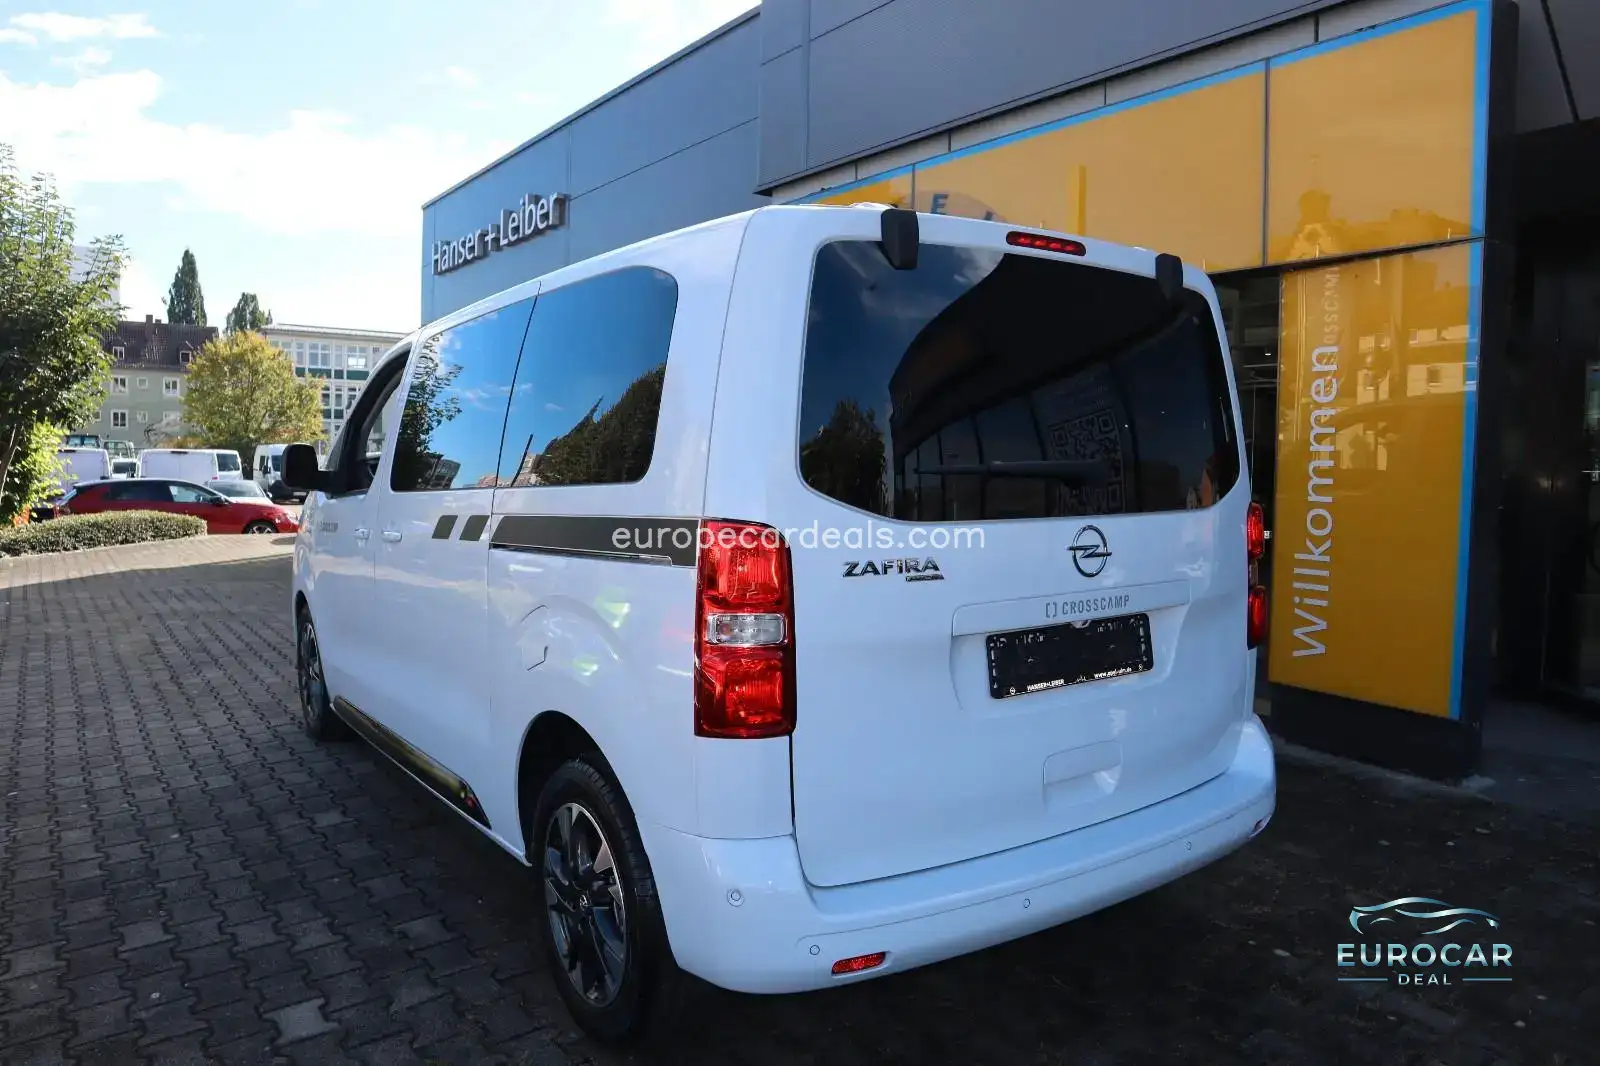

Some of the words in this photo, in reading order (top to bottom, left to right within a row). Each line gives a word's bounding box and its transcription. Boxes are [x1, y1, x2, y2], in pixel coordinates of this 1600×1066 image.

[432, 192, 565, 275] Hanser+Leiber
[1292, 345, 1340, 657] Willkommen
[842, 557, 940, 578] ZAFIRA
[1062, 594, 1130, 615] CROSSCAMP
